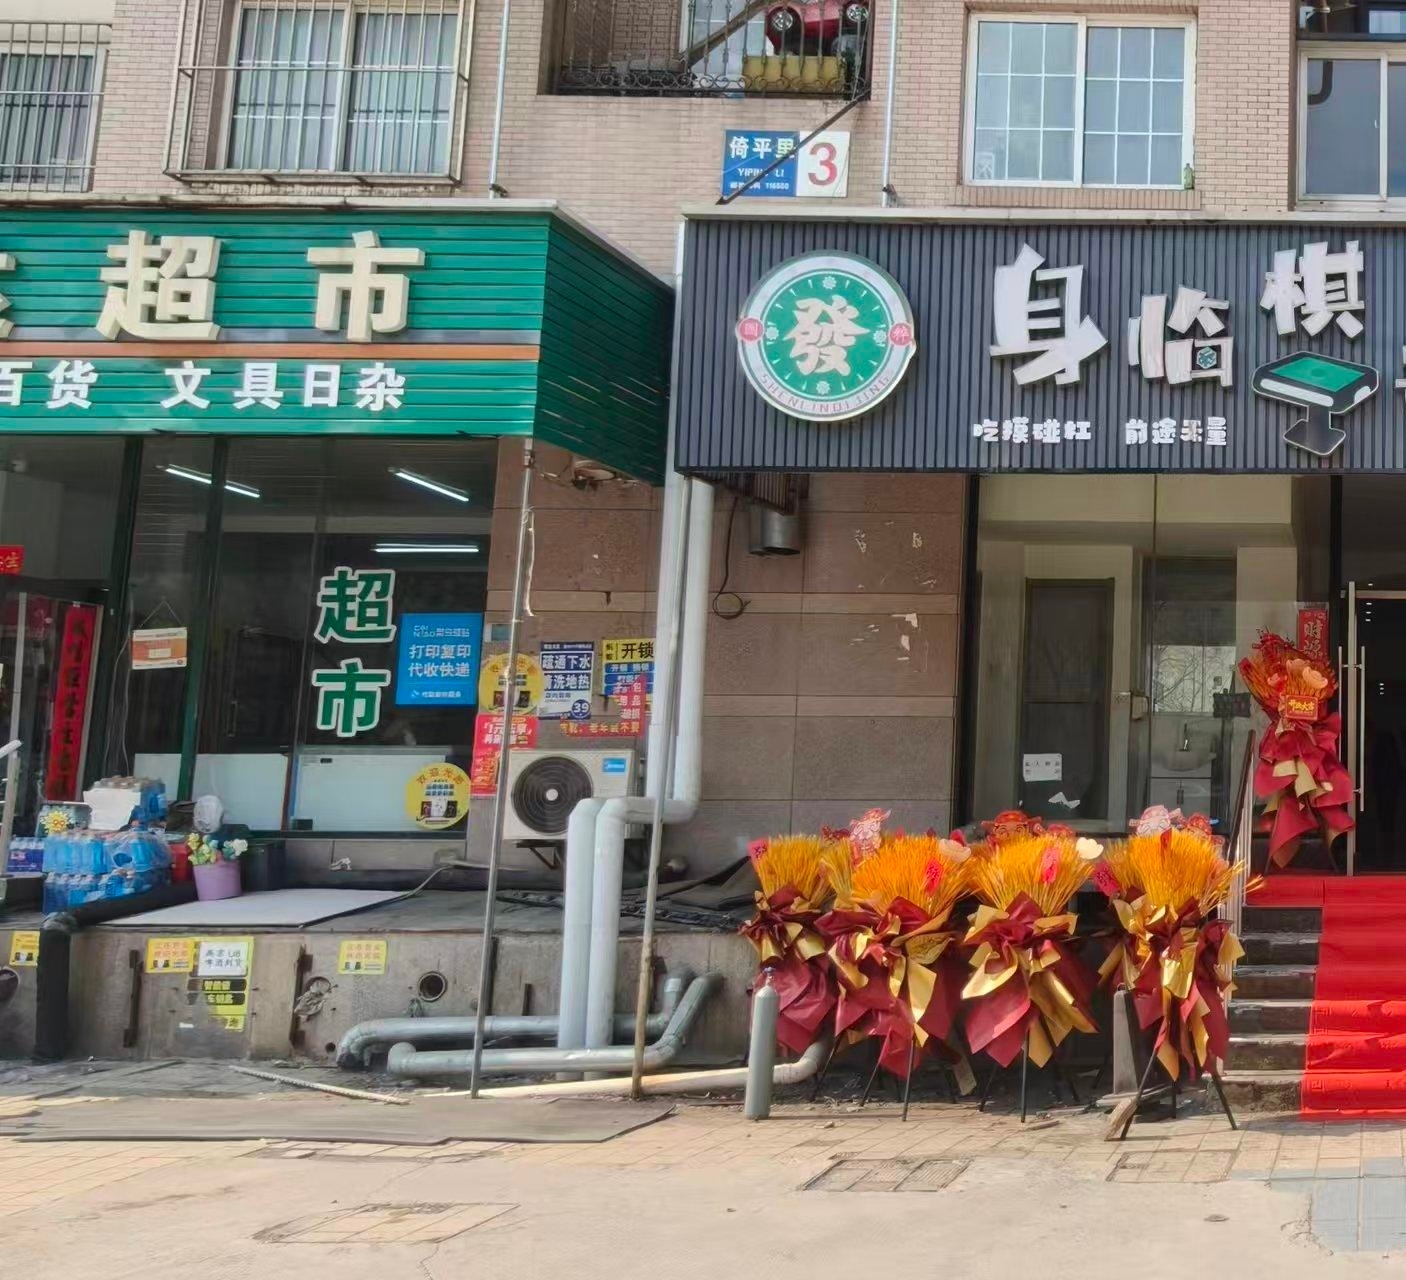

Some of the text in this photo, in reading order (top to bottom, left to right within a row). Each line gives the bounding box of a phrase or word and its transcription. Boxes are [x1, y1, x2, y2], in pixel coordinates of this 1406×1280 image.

[729, 136, 795, 159] 倚平里
[738, 168, 769, 177] YIPIN
[808, 142, 838, 186] 3
[0, 230, 425, 342] 超市
[161, 361, 406, 412] 文具日杂
[311, 566, 397, 738] 超市
[408, 644, 471, 659] 打印复印
[621, 642, 654, 659] 开锁
[407, 662, 470, 678] 代收快递
[542, 654, 591, 670] 疏通下水
[573, 702, 590, 713] 39
